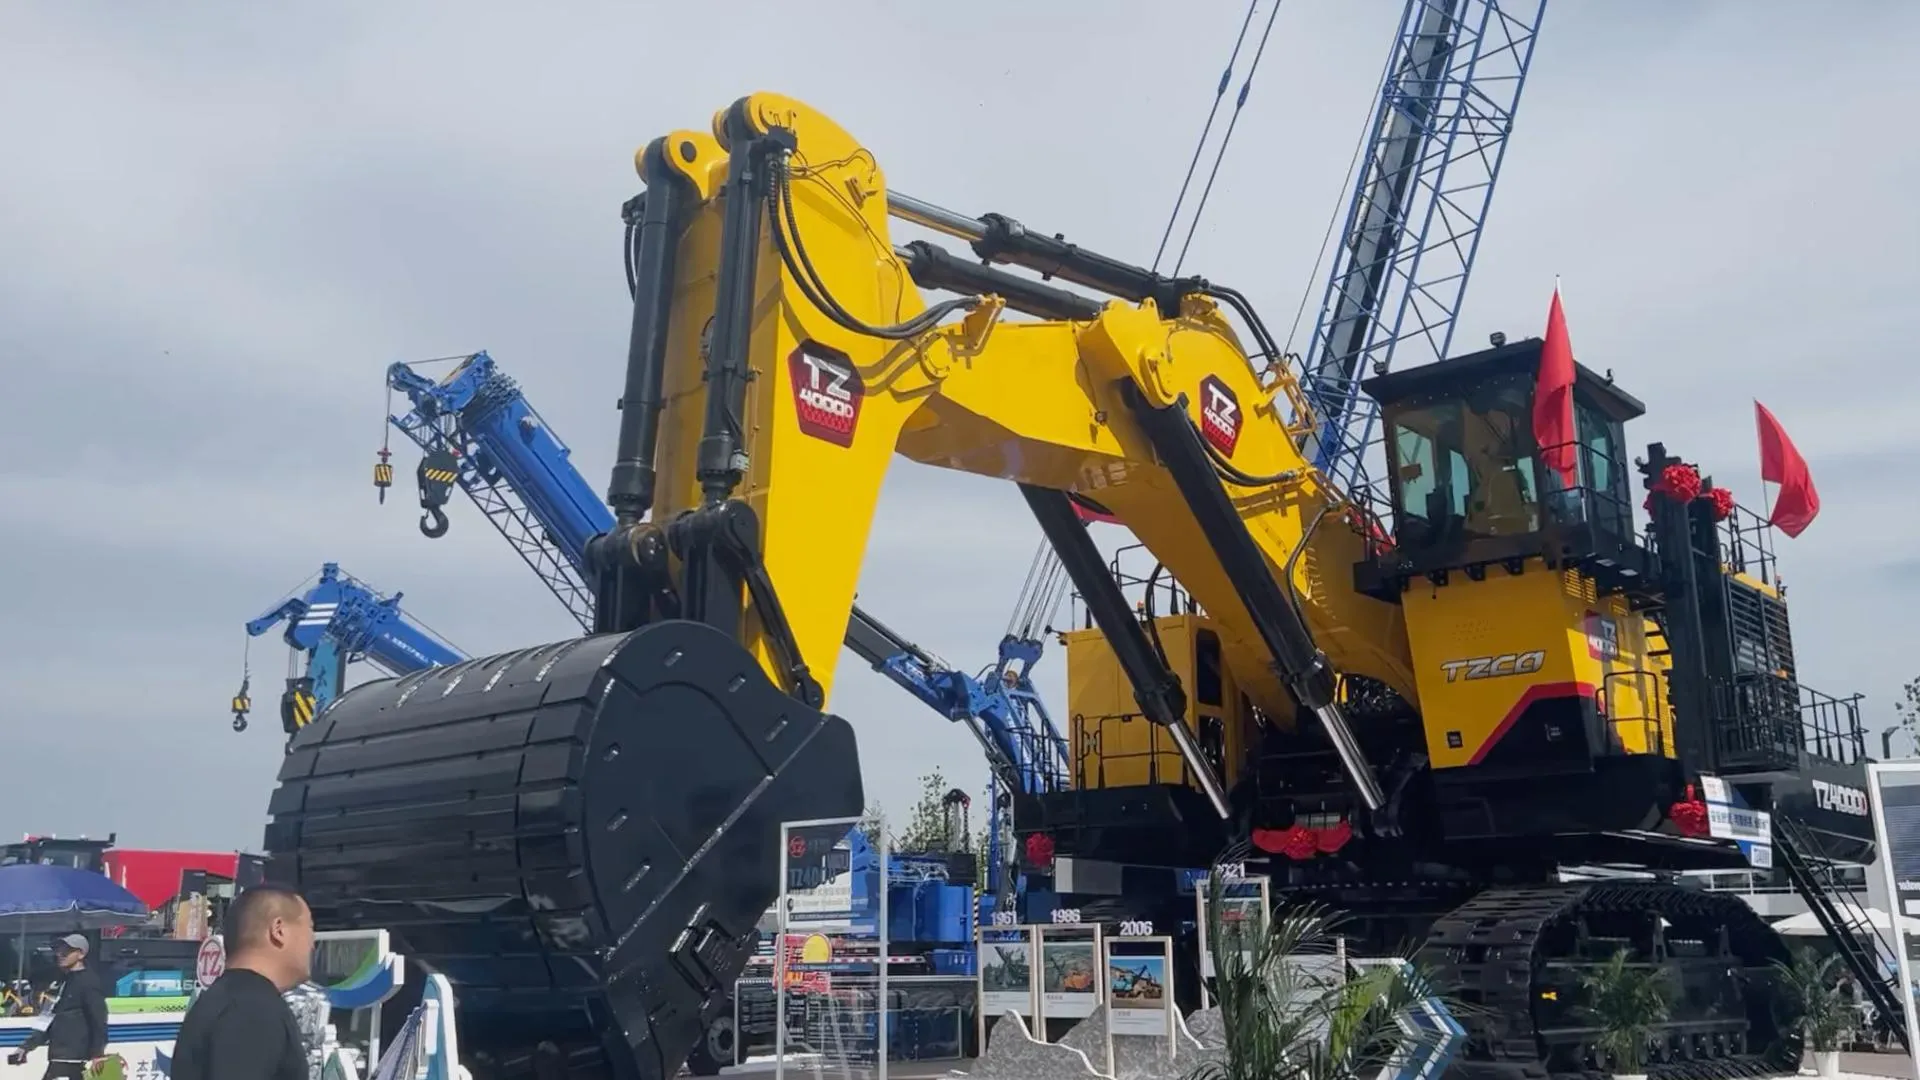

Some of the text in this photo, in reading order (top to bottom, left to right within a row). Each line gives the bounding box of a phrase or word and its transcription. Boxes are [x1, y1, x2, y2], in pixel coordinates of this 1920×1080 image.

[803, 352, 851, 401] TZ
[799, 387, 854, 418] 4000D
[1208, 383, 1237, 427] TZ
[1812, 779, 1868, 817] TZ4000D
[990, 910, 1018, 925] 1961
[1050, 908, 1081, 923] 1986
[1119, 920, 1153, 936] 2006
[200, 950, 222, 977] TZ
